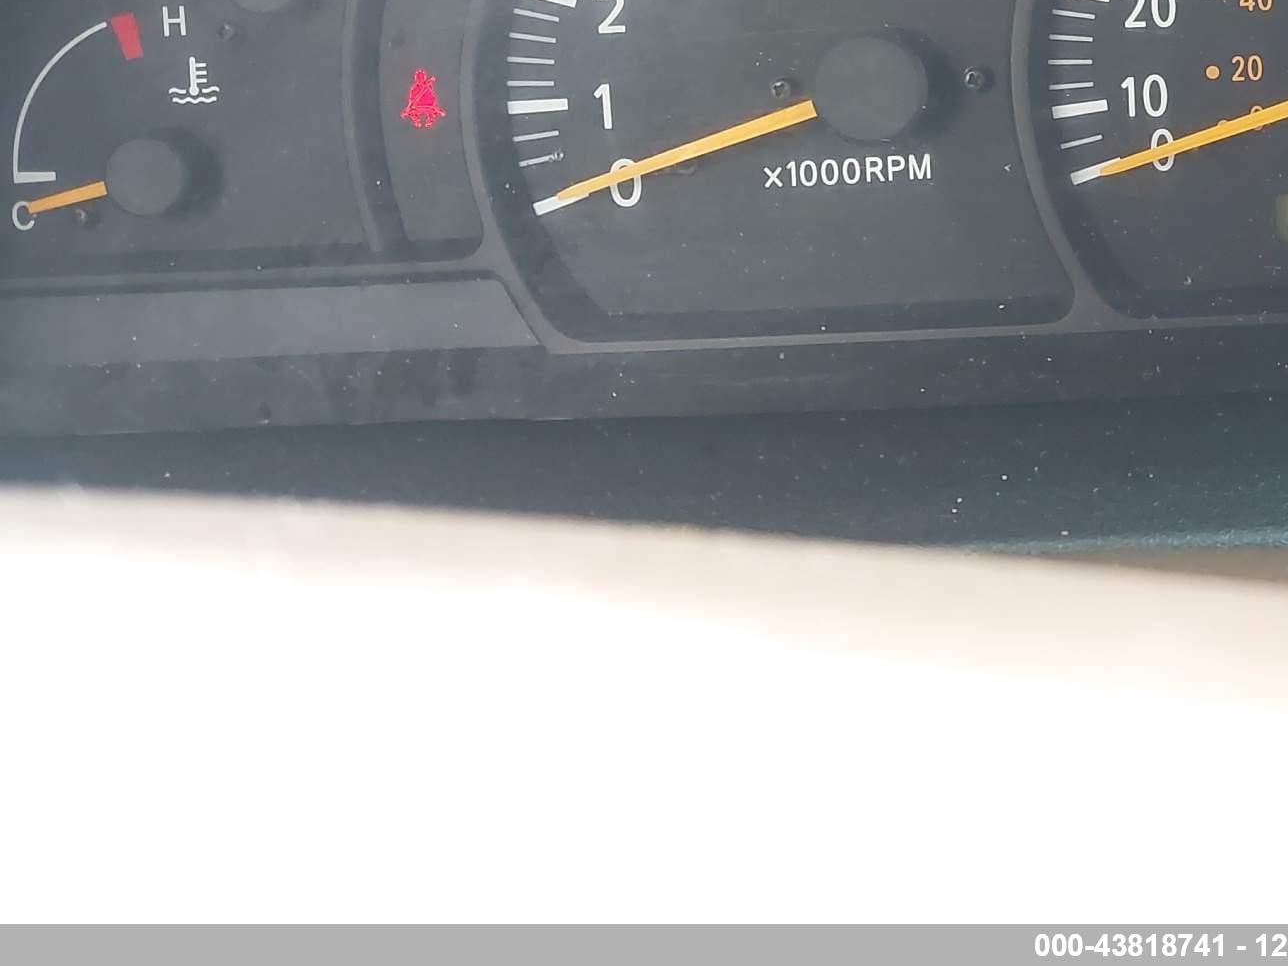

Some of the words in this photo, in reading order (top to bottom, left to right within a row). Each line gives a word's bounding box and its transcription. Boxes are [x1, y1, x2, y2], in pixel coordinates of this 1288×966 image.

[162, 5, 187, 37] H
[1231, 55, 1264, 82] 20
[593, 83, 614, 130] 1
[1120, 74, 1168, 118] 10
[1150, 128, 1175, 172] 0
[608, 159, 643, 208] 0
[11, 200, 37, 231] C
